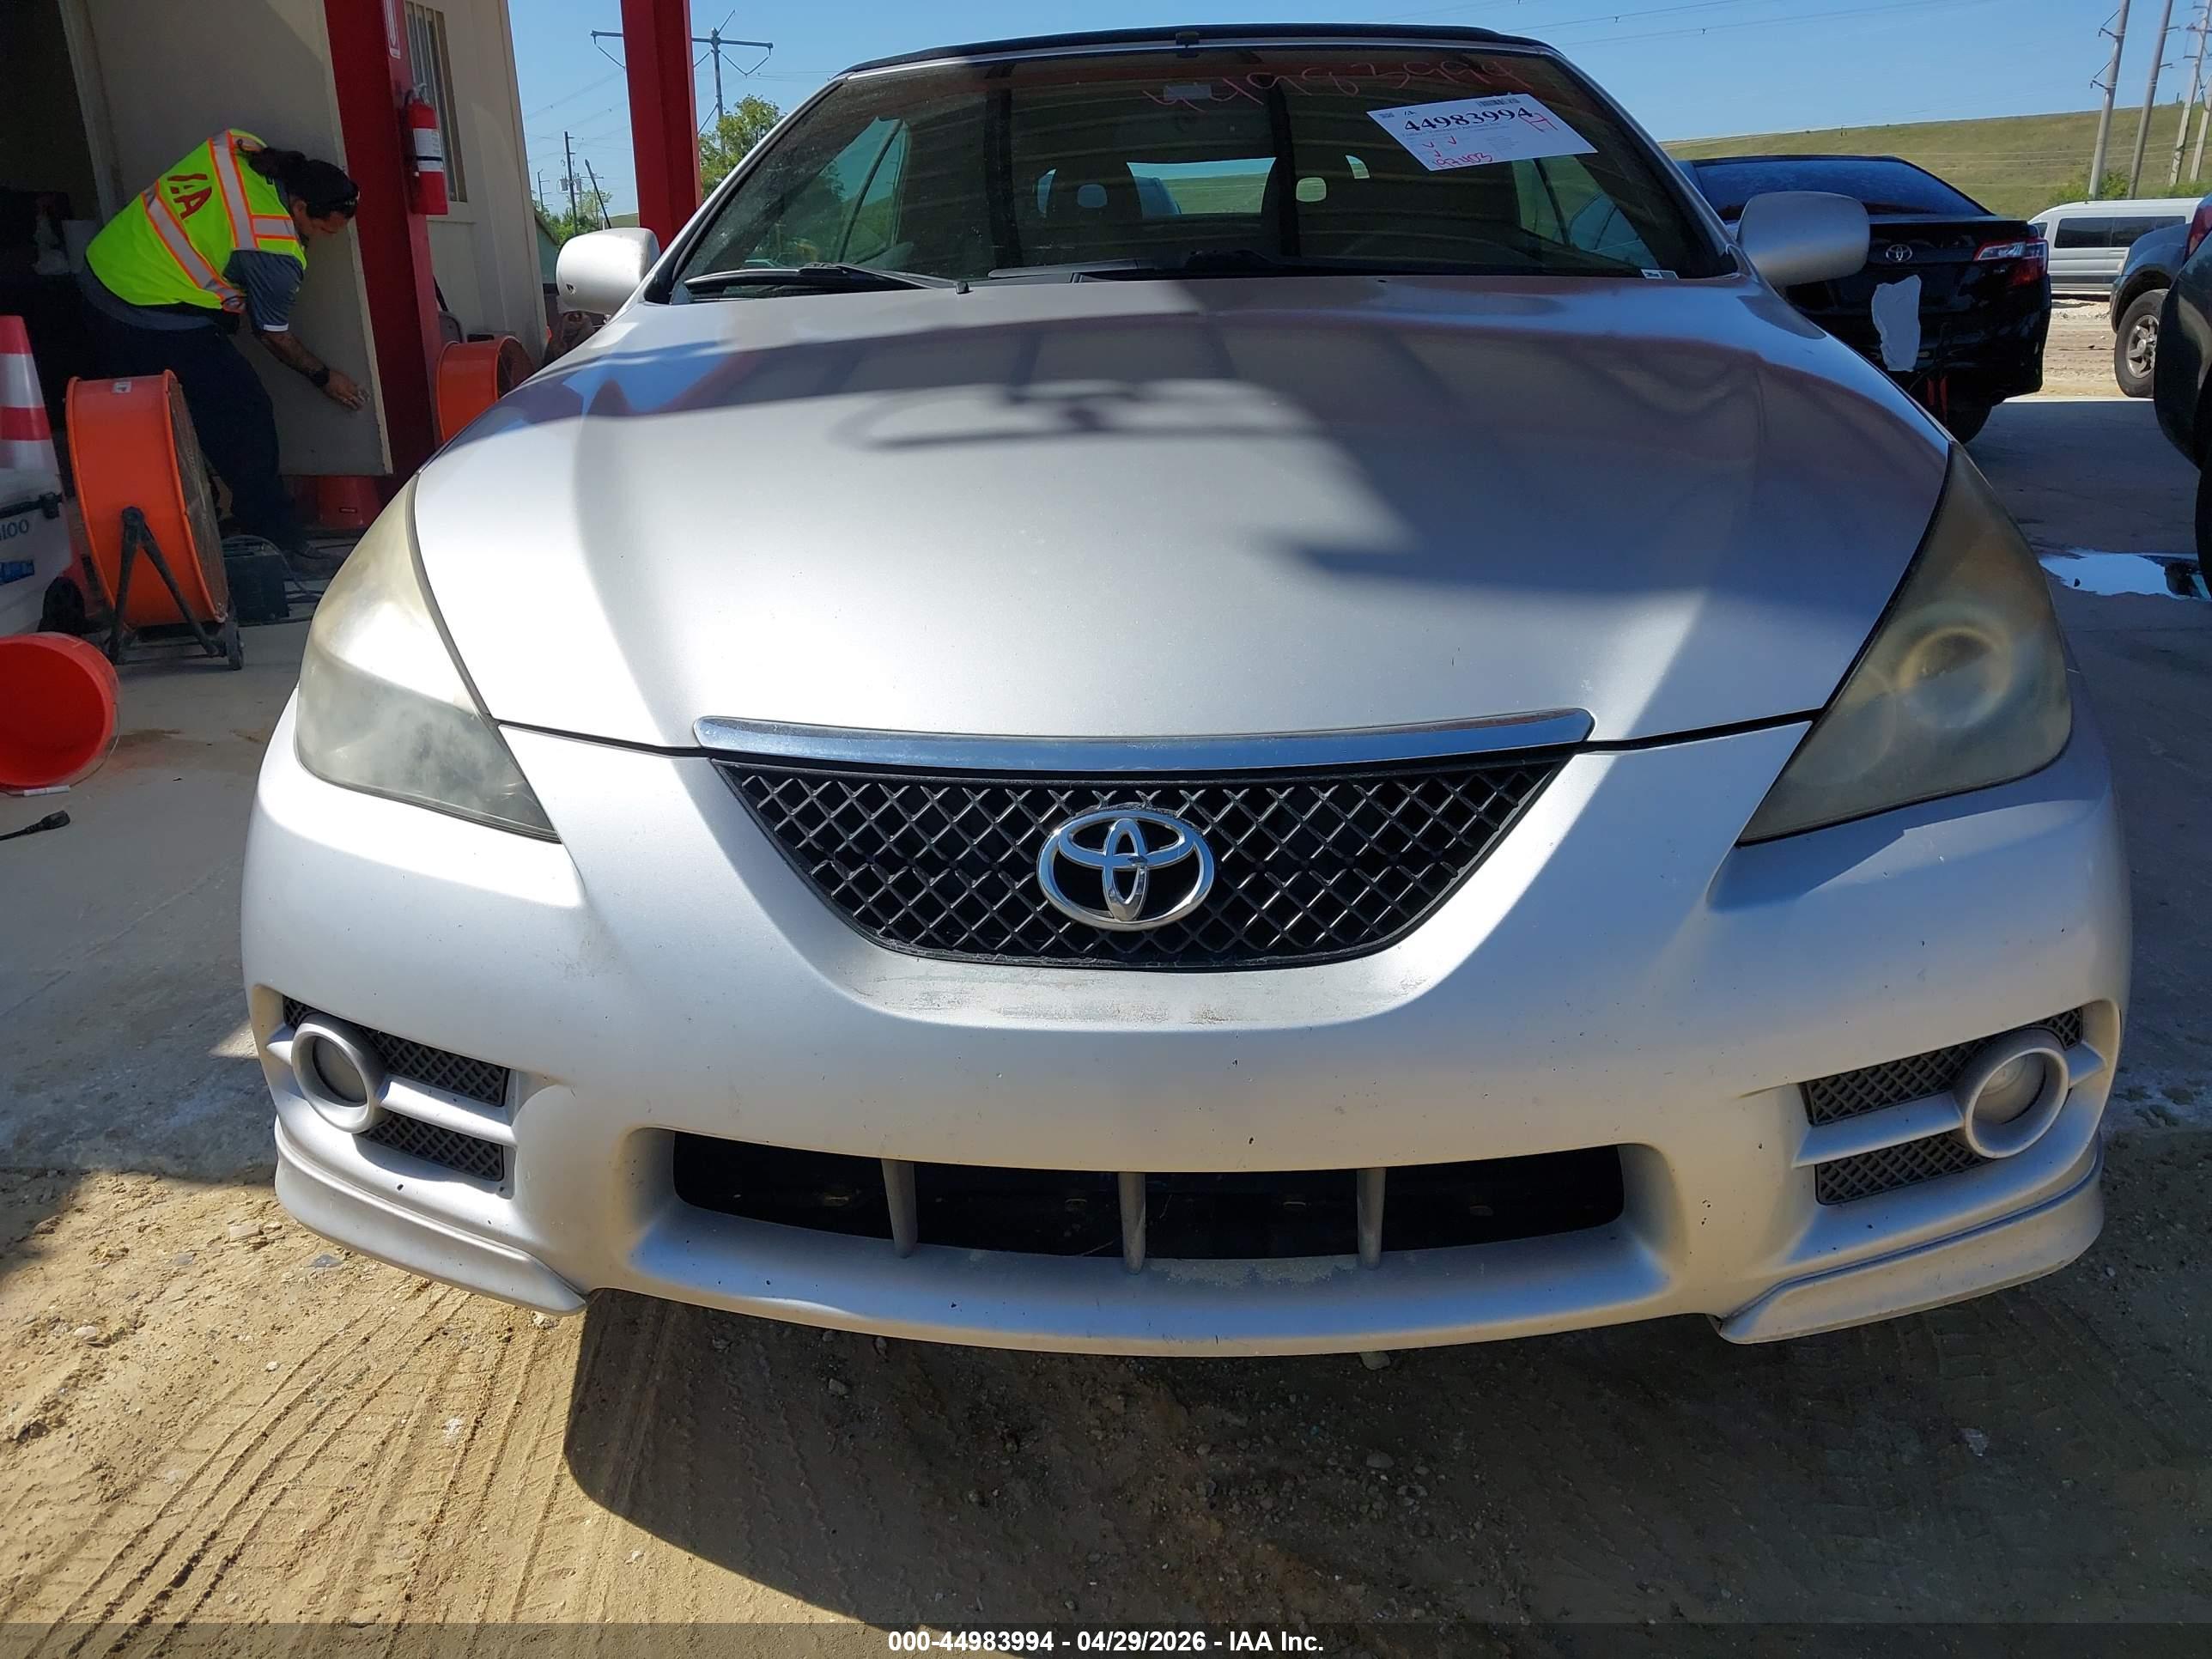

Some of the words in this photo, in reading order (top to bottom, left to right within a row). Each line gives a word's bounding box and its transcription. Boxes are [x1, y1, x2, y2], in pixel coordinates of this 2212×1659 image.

[1405, 106, 1534, 131] 44983994
[167, 173, 212, 220] IA
[0, 519, 29, 541] 100
